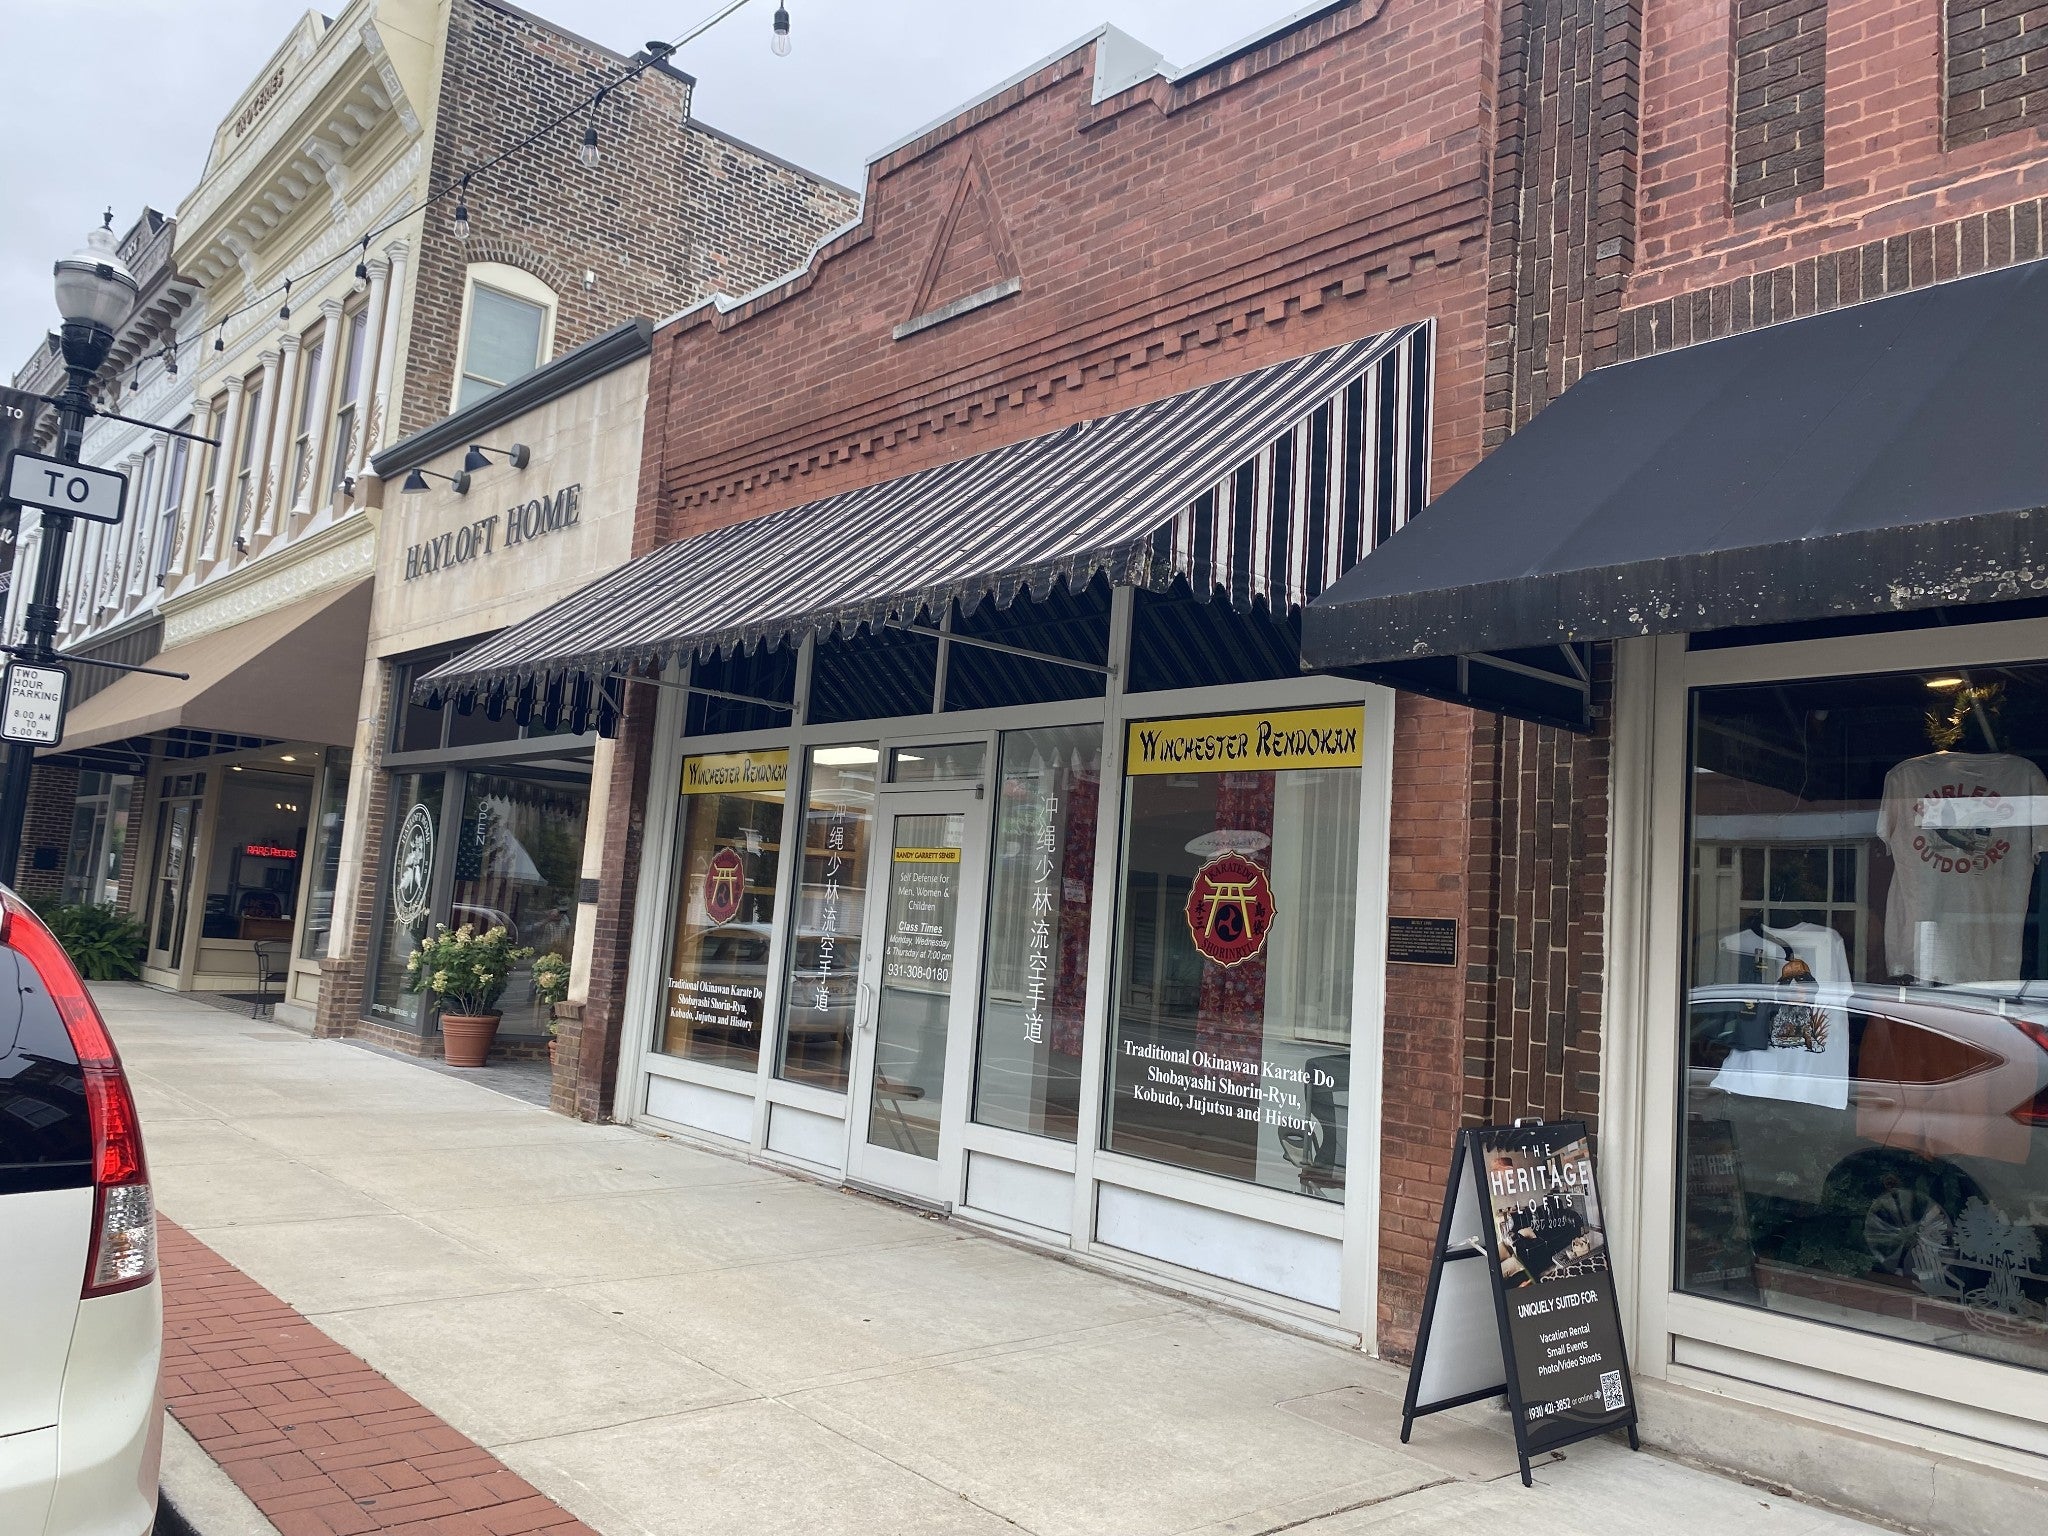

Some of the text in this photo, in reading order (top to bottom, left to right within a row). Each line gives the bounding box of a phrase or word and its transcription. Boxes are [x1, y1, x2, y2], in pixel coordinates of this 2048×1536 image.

[6, 405, 23, 419] TO
[44, 470, 89, 503] TO
[404, 483, 581, 581] HAYLOFT HOME
[13, 679, 43, 689] HOUR
[16, 669, 38, 679] TWO
[12, 687, 58, 702] PARKING
[26, 719, 37, 728] TO
[38, 713, 51, 721] AM
[36, 730, 48, 738] PM
[1140, 720, 1357, 762] WINCHESTER RENDOKAN
[689, 763, 740, 785] WINCHESTER
[475, 801, 489, 846] OPEN
[1912, 836, 2010, 873] OUTDOORS
[900, 872, 950, 883] Self Defense for
[1208, 862, 1256, 880] KARATEDO
[916, 887, 941, 898] Women
[943, 888, 949, 898] &
[908, 900, 936, 911] Children
[898, 920, 943, 934] Class Times
[915, 936, 950, 950] Wednesday
[1202, 939, 1253, 958] SHORINRYU
[886, 946, 952, 962] & Thursday at 7:00 pm
[887, 963, 949, 981] 931-308-0180
[667, 977, 763, 999] Traditional Okinawan Karate Do
[677, 993, 747, 1015] Shobayashi Shorin-Ryu,
[670, 1007, 754, 1032] Kobudo, Jujutsu and History
[1124, 1040, 1335, 1088] Traditional Okinawan Karate Do
[1147, 1066, 1301, 1110] Shobayashi Shorin-Ryu,
[1133, 1085, 1317, 1135] Kobudo, Jujutsu and History
[1521, 1143, 1551, 1159] THE
[1490, 1160, 1589, 1196] HERITAGE
[1516, 1194, 1573, 1215] LOFTS
[1517, 1289, 1599, 1319] UNIQUELY SUITED FOR:
[1540, 1323, 1591, 1344] Vacation Rental
[1546, 1340, 1589, 1358] Small Events
[1538, 1352, 1602, 1377] Photo/Video Shoots
[1528, 1404, 1544, 1421] (931)
[1544, 1398, 1571, 1415] 421-3852
[1578, 1393, 1594, 1404] online
